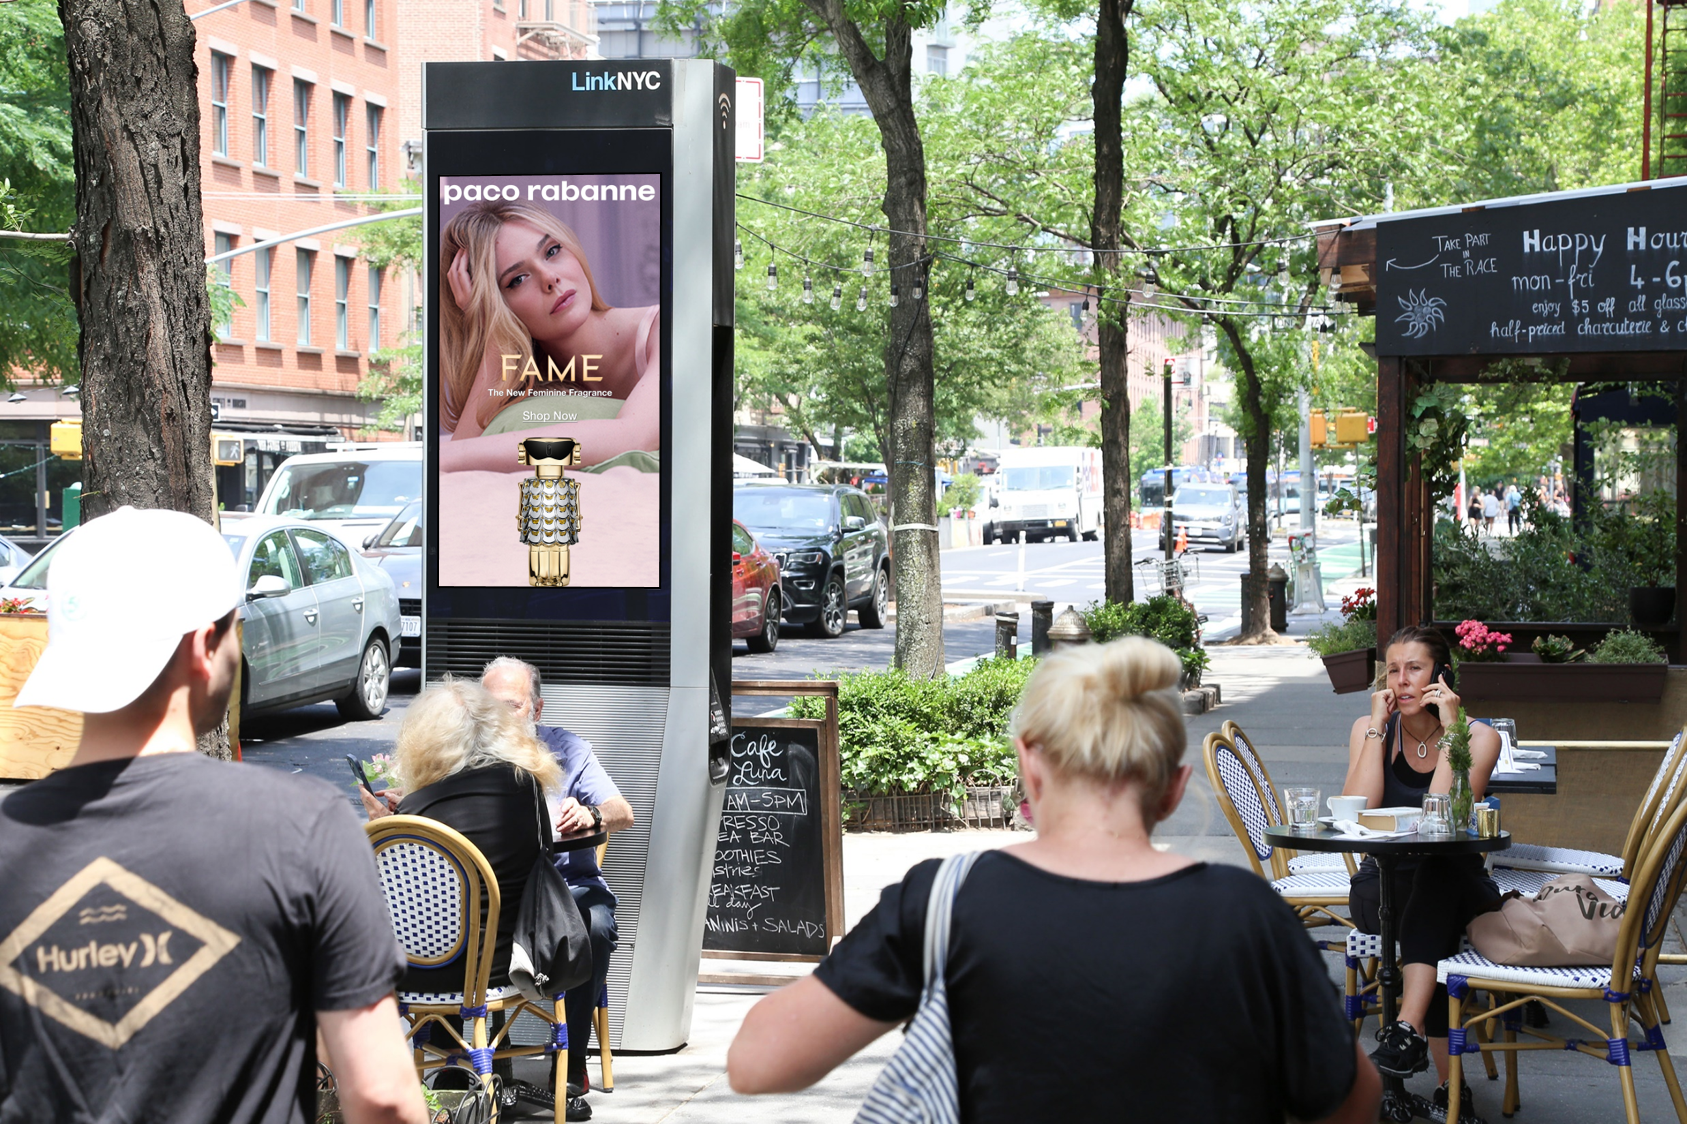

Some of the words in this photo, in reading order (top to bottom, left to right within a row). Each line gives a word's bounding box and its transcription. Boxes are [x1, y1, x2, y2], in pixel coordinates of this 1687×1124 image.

[571, 71, 661, 91] LinkNYC
[444, 181, 520, 205] paco
[527, 180, 656, 201] rabanne
[1464, 233, 1492, 247] PART
[1523, 229, 1607, 268] Happy
[1440, 263, 1462, 279] THE
[1466, 258, 1498, 276] RACE
[1532, 301, 1562, 317] enjoy
[1572, 300, 1590, 316] $5
[1597, 298, 1616, 318] off
[1628, 295, 1647, 312] all
[1577, 318, 1652, 335] charcuterie
[1659, 320, 1671, 333] &
[501, 354, 604, 382] FAME
[488, 389, 504, 397] The
[506, 389, 525, 397] New
[527, 389, 567, 397] Feminine
[568, 389, 613, 399] Fragrance
[522, 411, 551, 422] Shop
[553, 411, 578, 421] Now
[730, 731, 784, 769] Cafe
[732, 761, 787, 786] Luna
[720, 815, 780, 832] RESSO
[717, 830, 742, 843] EA
[750, 831, 790, 847] BAR
[714, 849, 782, 865] OOTHIES
[712, 863, 762, 879] stries
[709, 884, 781, 902] EAKFAST
[762, 917, 825, 939] SALADS
[36, 940, 138, 974] Hurley
